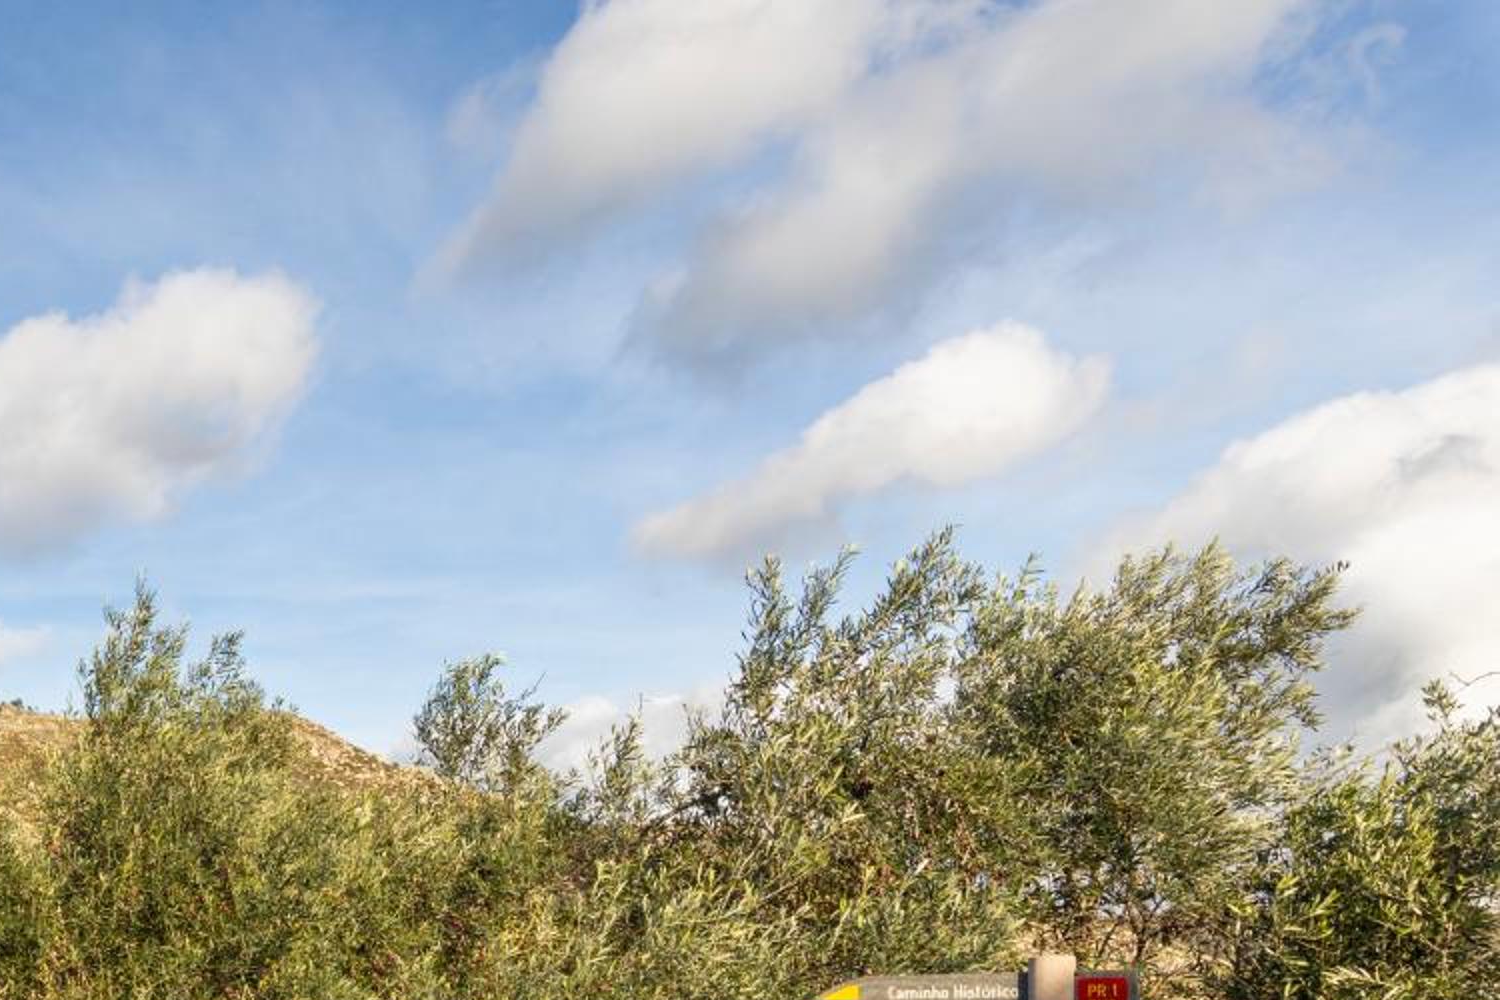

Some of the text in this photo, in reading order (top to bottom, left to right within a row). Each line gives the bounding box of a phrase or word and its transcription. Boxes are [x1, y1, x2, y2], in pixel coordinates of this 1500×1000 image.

[887, 983, 1019, 1000] Caminho Histórico
[1088, 984, 1107, 997] PR
